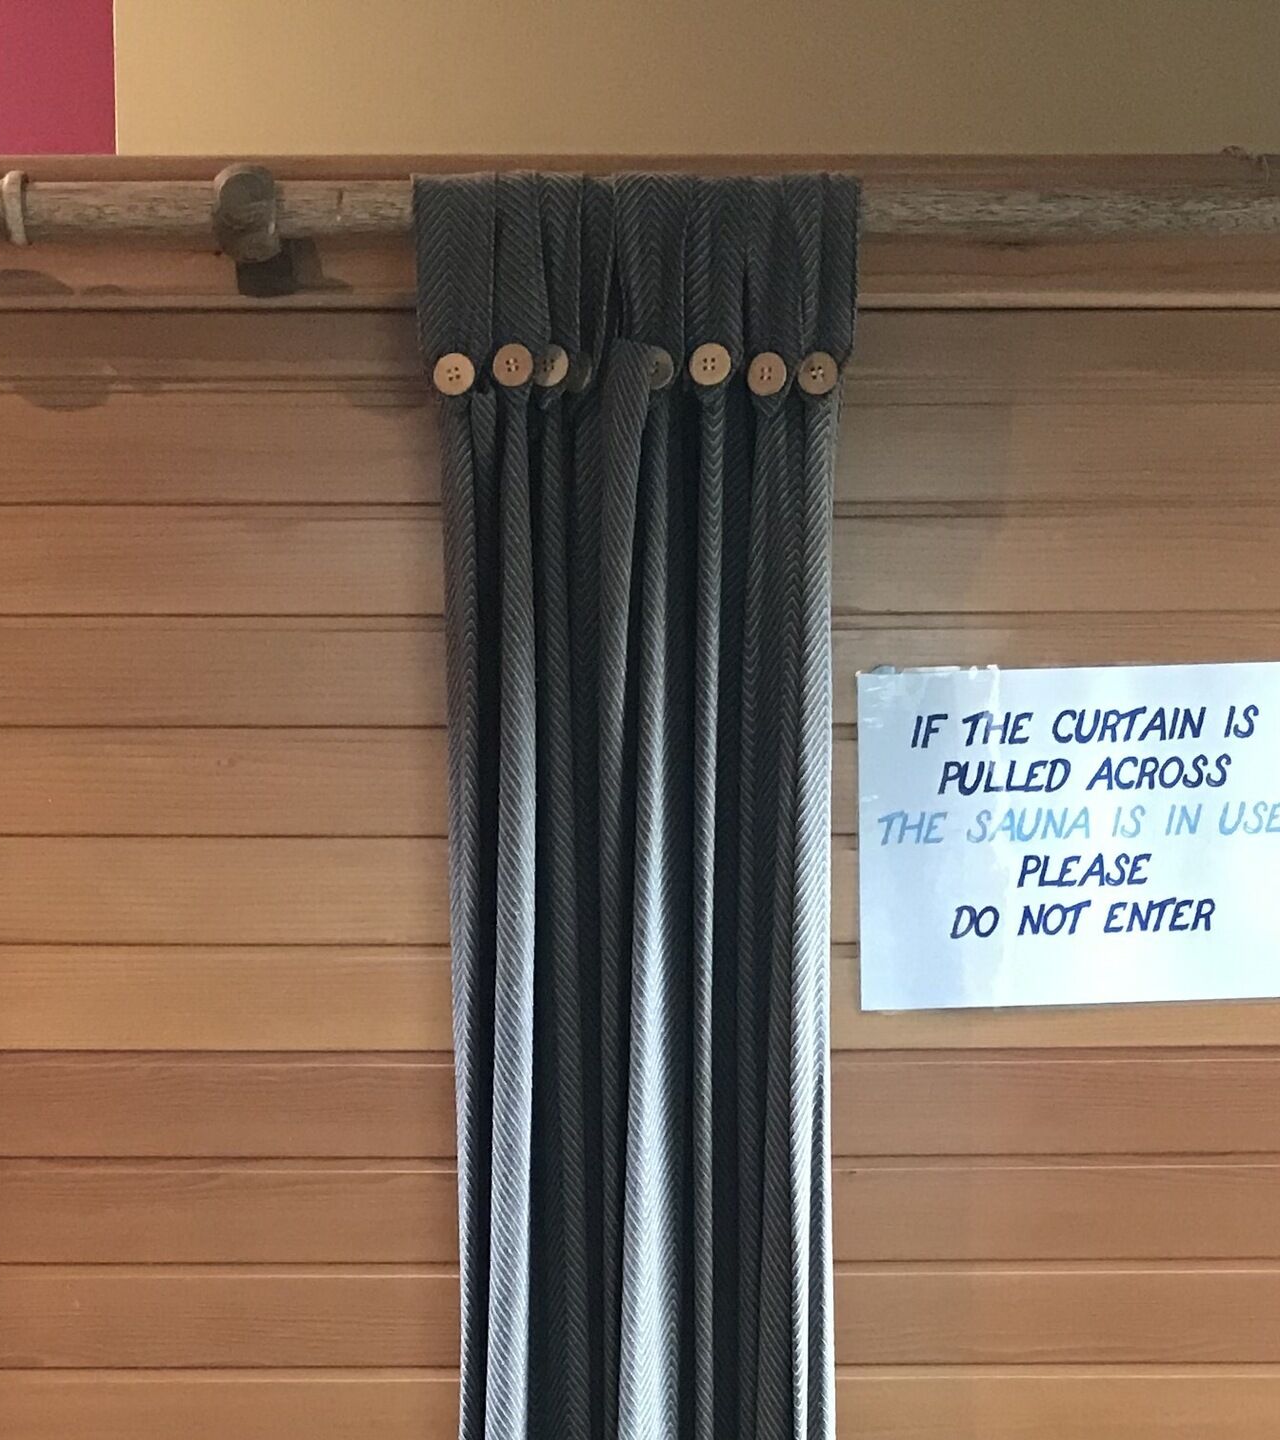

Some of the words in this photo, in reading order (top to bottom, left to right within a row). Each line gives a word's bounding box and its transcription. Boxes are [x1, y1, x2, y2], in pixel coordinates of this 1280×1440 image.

[911, 713, 948, 748] IF
[962, 710, 1032, 746] THE
[1052, 705, 1206, 744] CURTAIN
[1224, 704, 1260, 739] IS
[938, 758, 1071, 796] PULLED
[1086, 753, 1232, 791] ACROSS
[878, 810, 948, 846] THE
[966, 807, 1090, 843] SAUNA
[1113, 805, 1146, 838] IS
[1165, 802, 1203, 836] IN
[1017, 853, 1152, 888] PLEASE
[950, 905, 1000, 939] DO
[1017, 899, 1090, 936] NOT
[1104, 898, 1216, 933] ENTER
